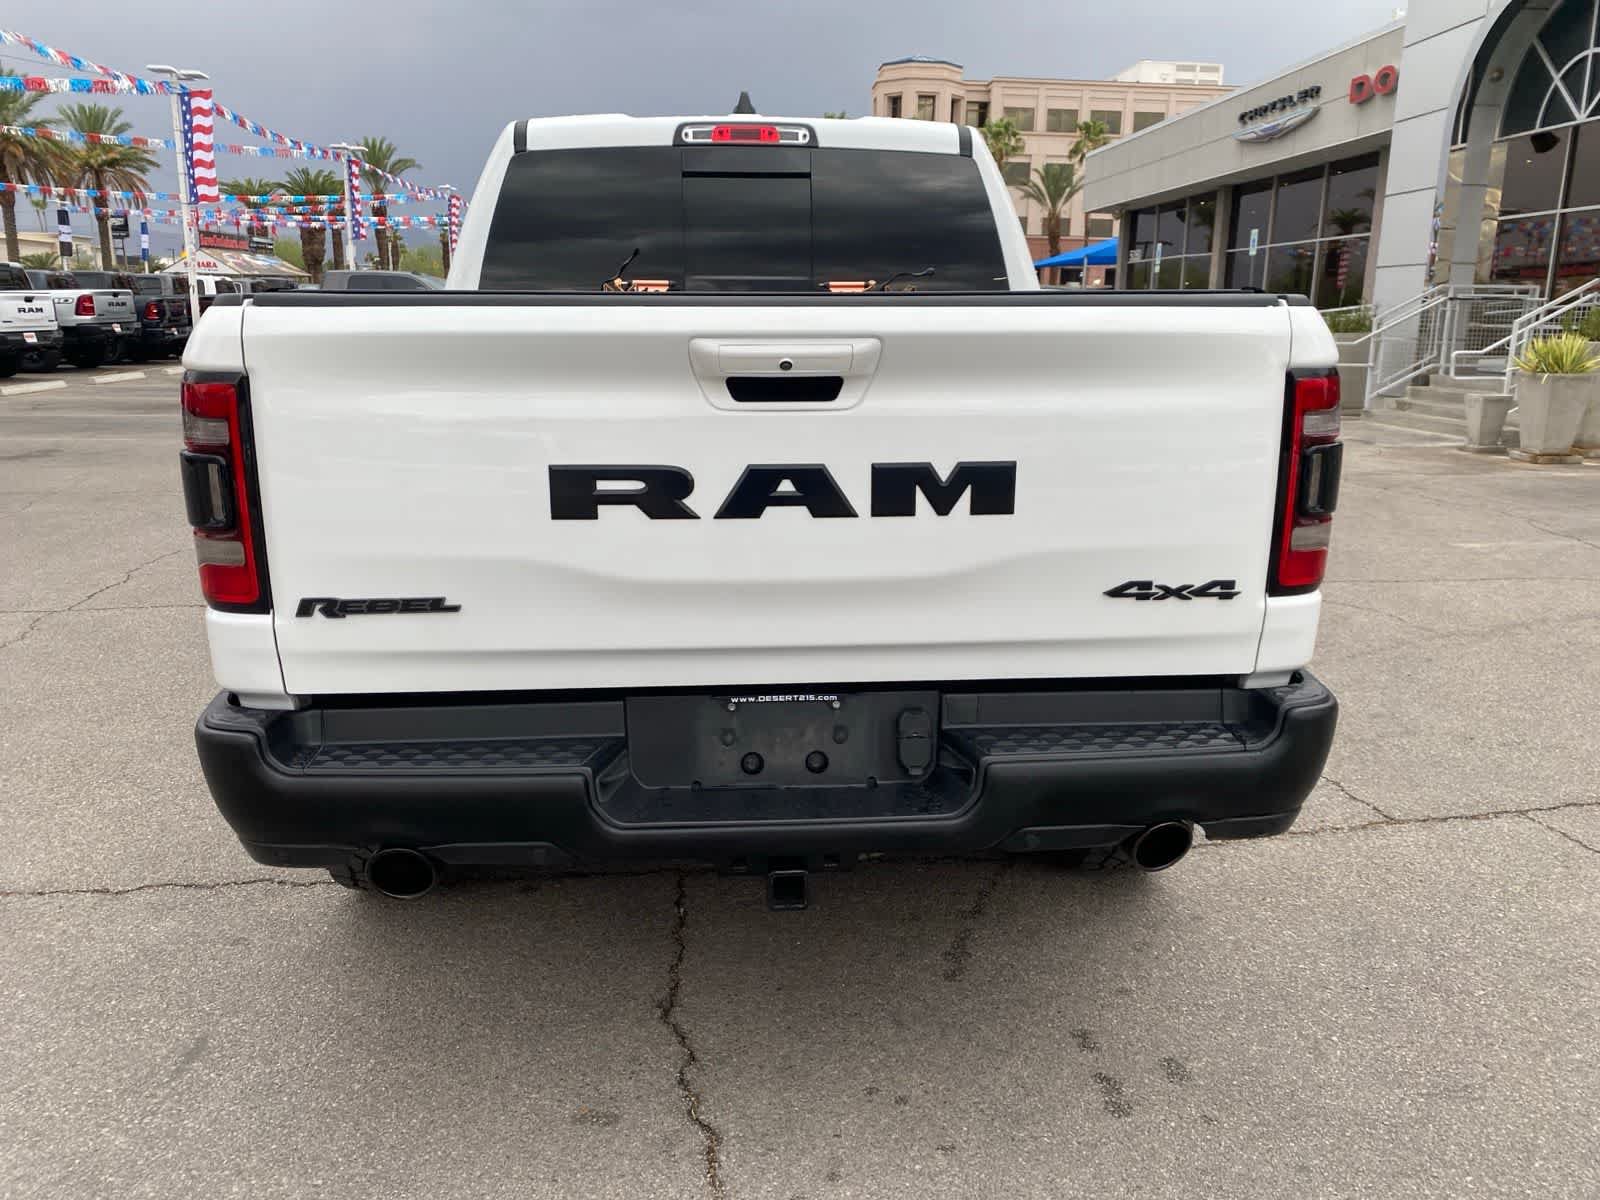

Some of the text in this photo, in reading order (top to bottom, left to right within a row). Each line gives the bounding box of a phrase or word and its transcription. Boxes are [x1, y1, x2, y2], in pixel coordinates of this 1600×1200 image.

[1238, 85, 1321, 125] CHRYSLER
[183, 260, 218, 269] SHARA
[17, 306, 44, 314] RAM
[548, 460, 1017, 520] RAM
[1102, 580, 1242, 601] 4x4
[295, 597, 462, 618] REBEL
